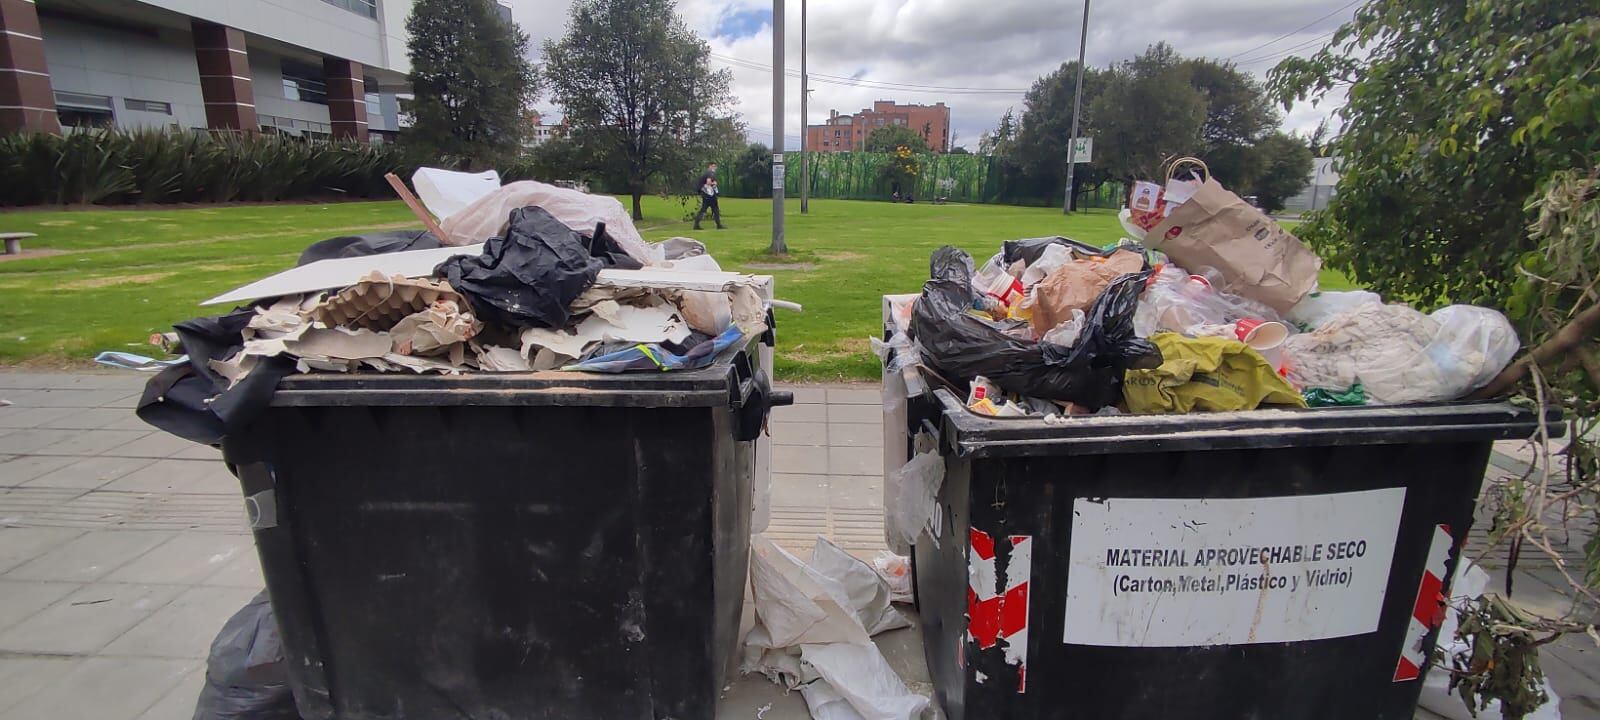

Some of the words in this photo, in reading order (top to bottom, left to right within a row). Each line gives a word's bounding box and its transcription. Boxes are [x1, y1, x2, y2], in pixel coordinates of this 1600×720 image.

[1106, 548, 1189, 567] MATERIAL
[1193, 544, 1323, 567] APROVECHABLE
[1326, 540, 1367, 561] SECO
[1291, 575, 1300, 592] y
[1306, 566, 1352, 588] Vidrio)
